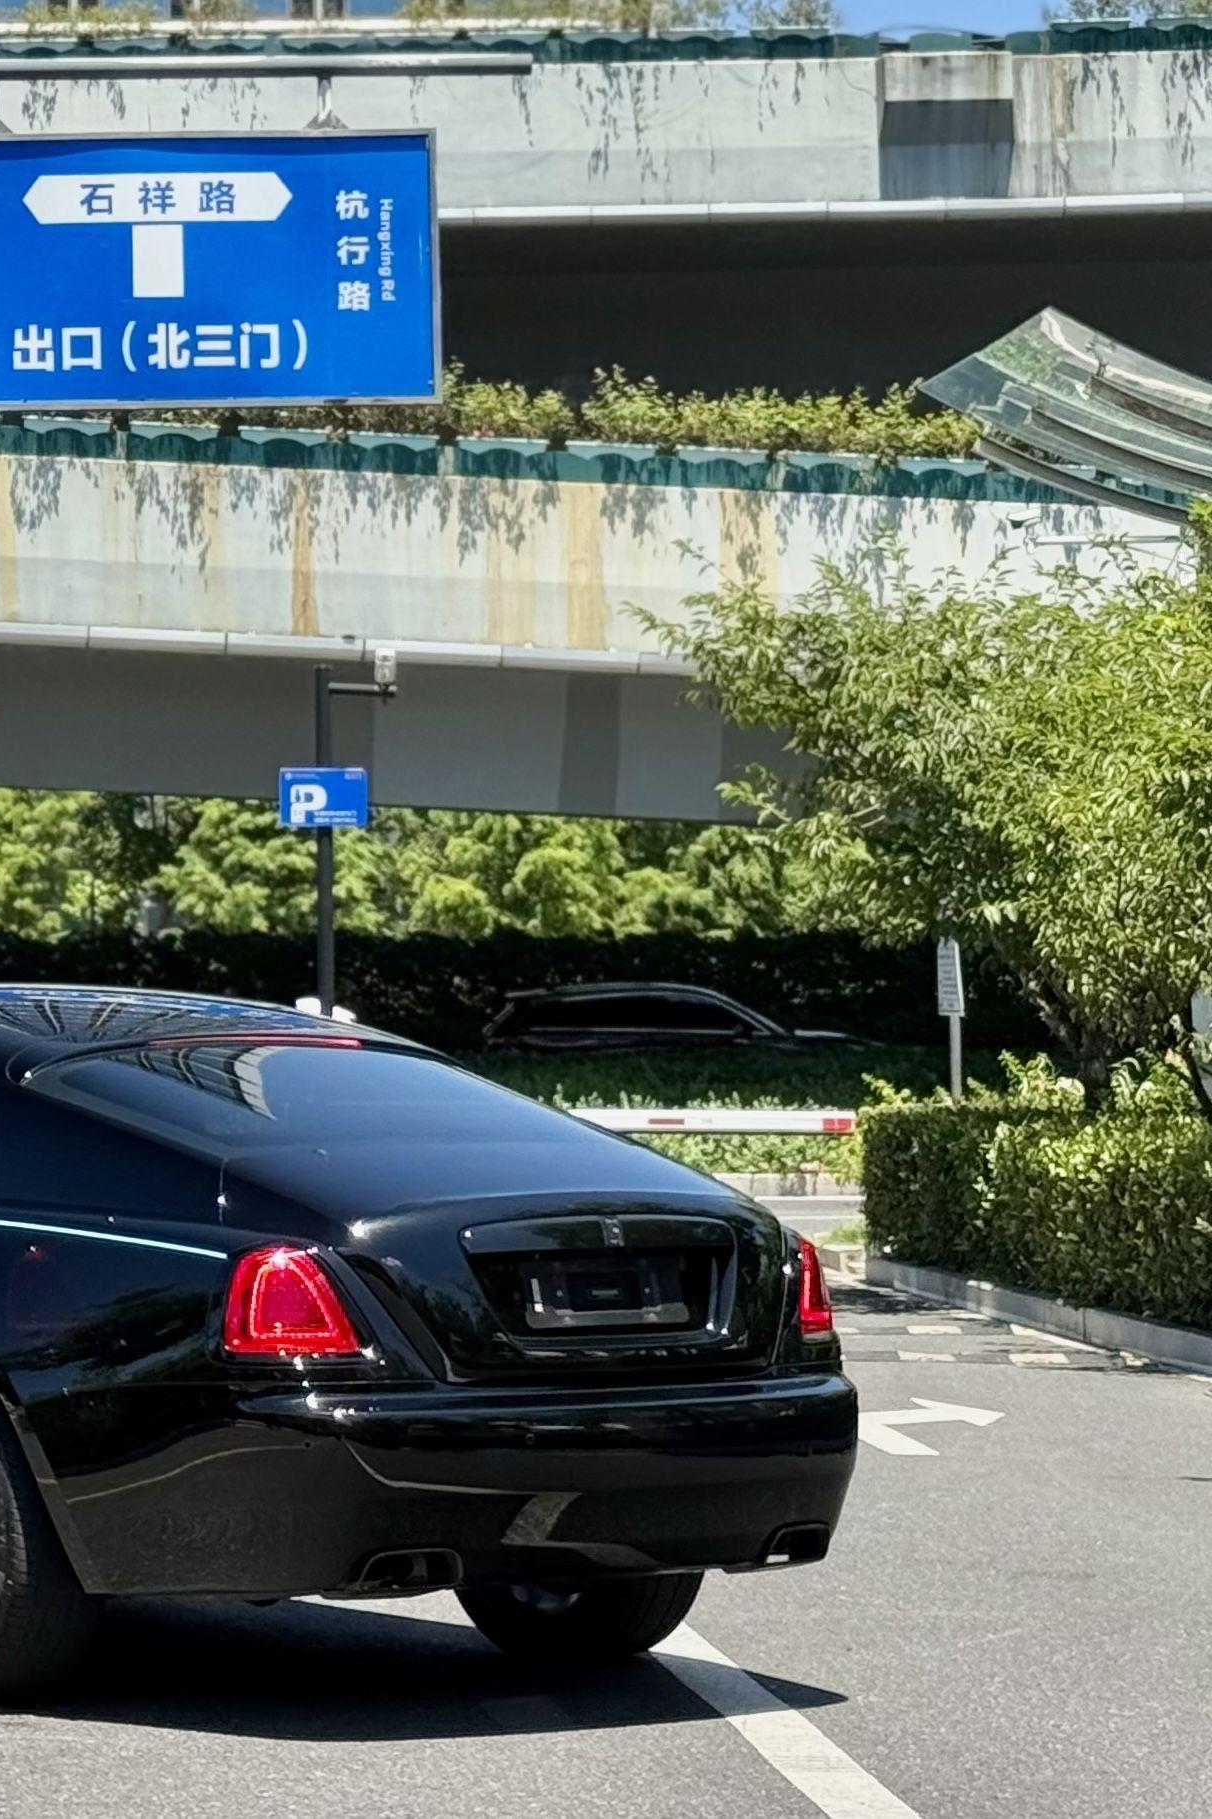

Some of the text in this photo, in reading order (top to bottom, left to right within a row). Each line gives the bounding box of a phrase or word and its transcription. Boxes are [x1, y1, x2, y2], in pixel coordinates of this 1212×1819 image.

[80, 180, 237, 216] 石祥路
[335, 189, 370, 311] 杭行路
[376, 198, 396, 301] Hangxing Rd
[290, 784, 328, 824] P
